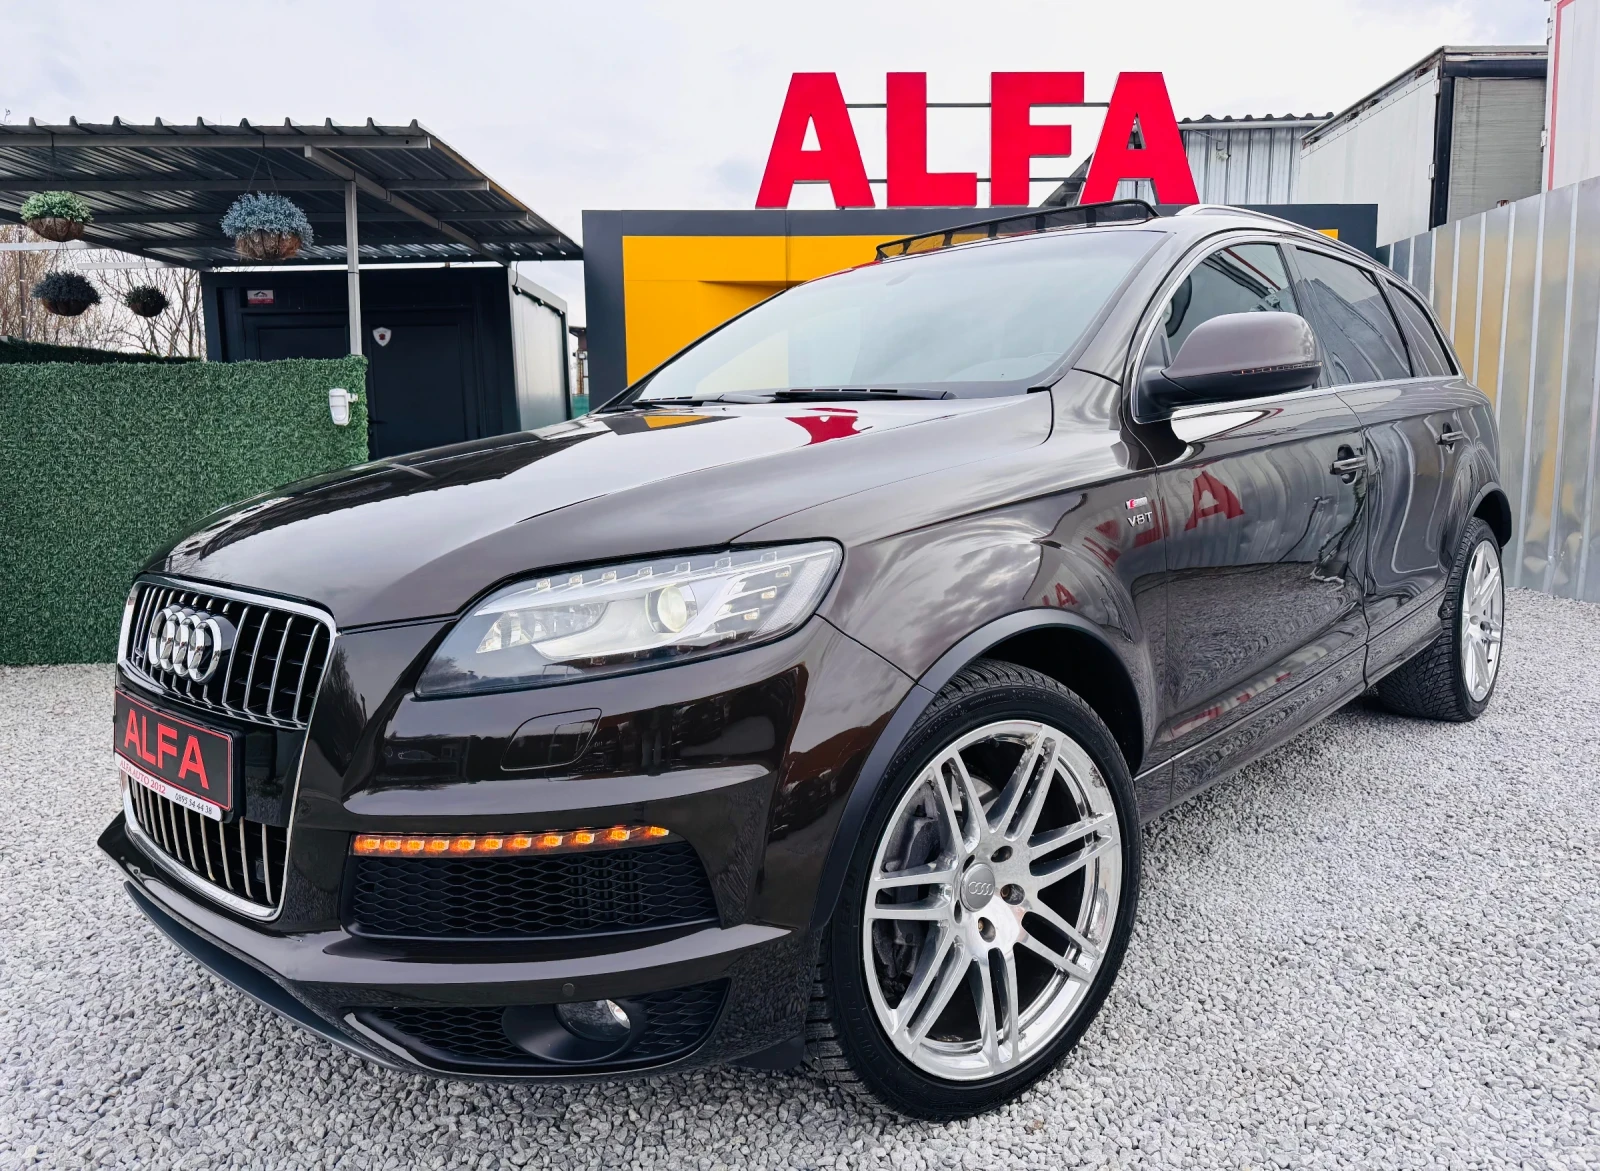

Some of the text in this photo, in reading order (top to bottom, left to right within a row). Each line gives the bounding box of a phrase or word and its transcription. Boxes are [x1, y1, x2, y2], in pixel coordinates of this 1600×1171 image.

[755, 71, 1200, 208] ALFA
[119, 759, 166, 794] ALFA AUTO 2012
[123, 708, 209, 790] ALFA
